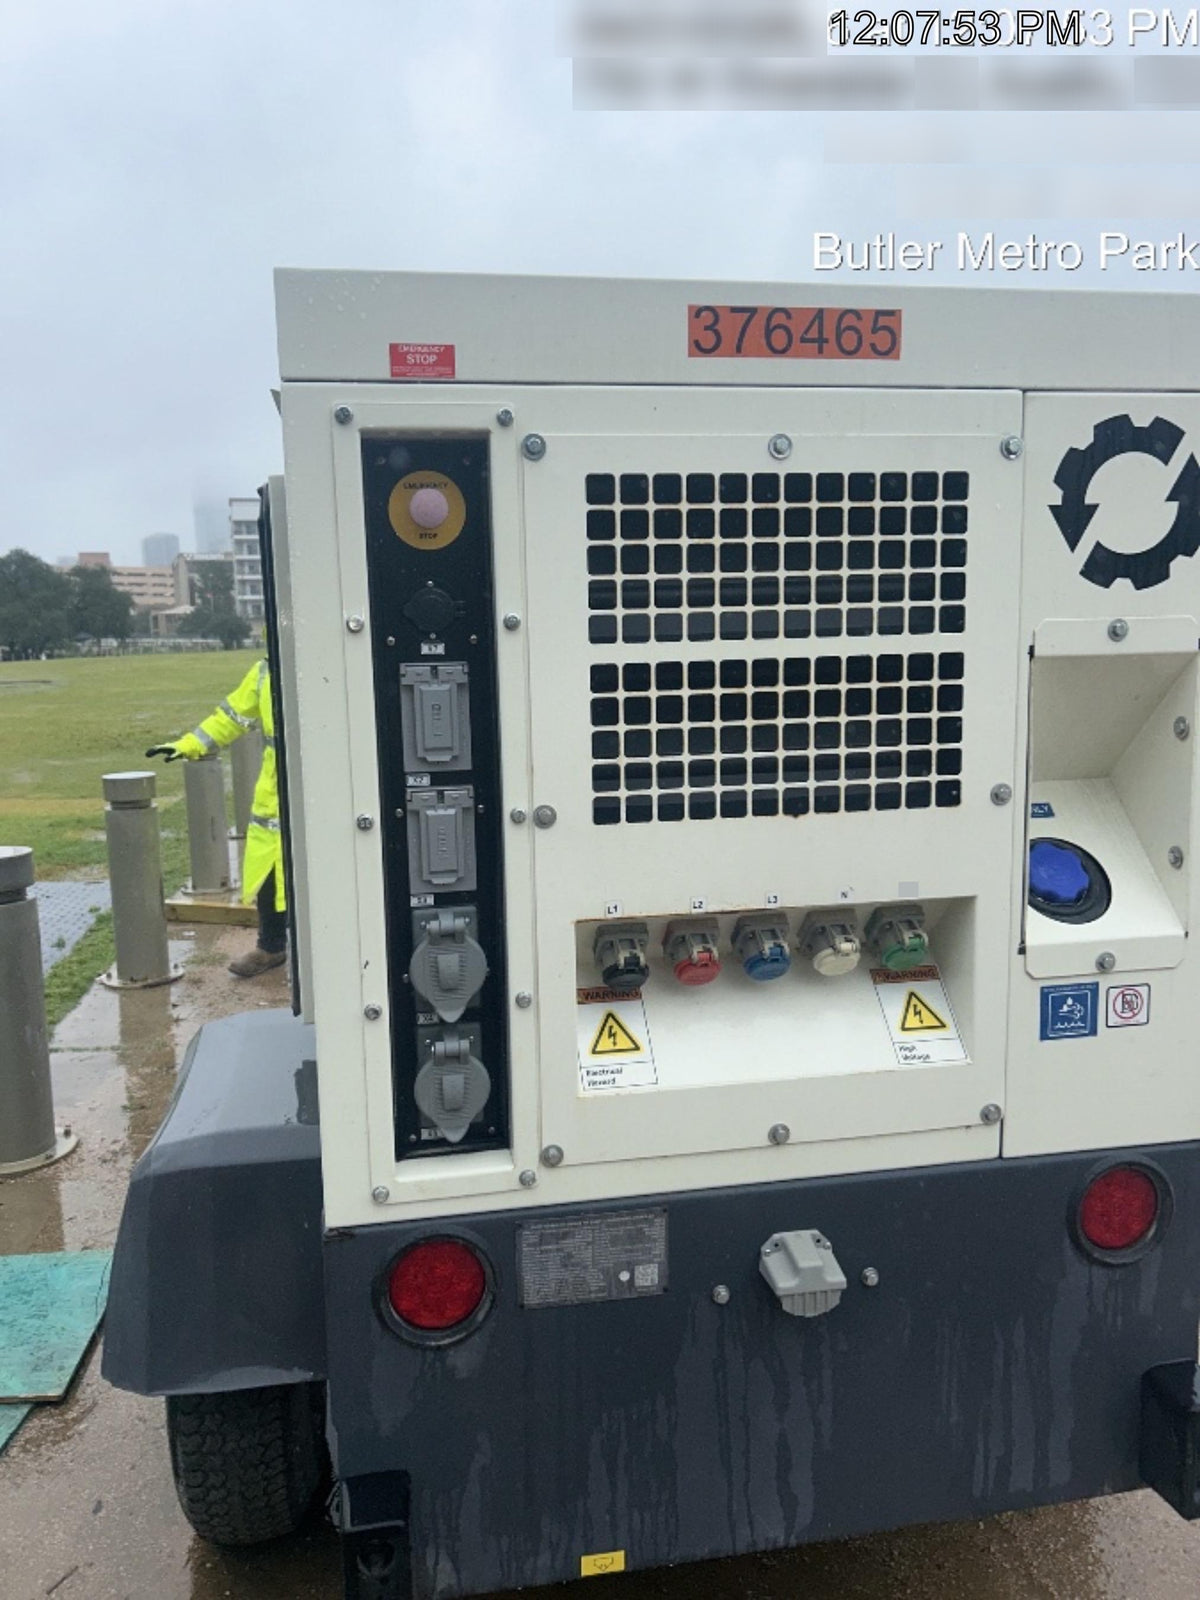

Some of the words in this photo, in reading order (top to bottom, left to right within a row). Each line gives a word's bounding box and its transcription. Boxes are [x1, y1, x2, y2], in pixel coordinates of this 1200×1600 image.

[693, 305, 897, 356] 376465
[406, 353, 438, 365] STOP
[693, 900, 703, 910] L2
[767, 895, 778, 905] L3
[607, 904, 618, 915] L1
[583, 989, 640, 1000] WARNING
